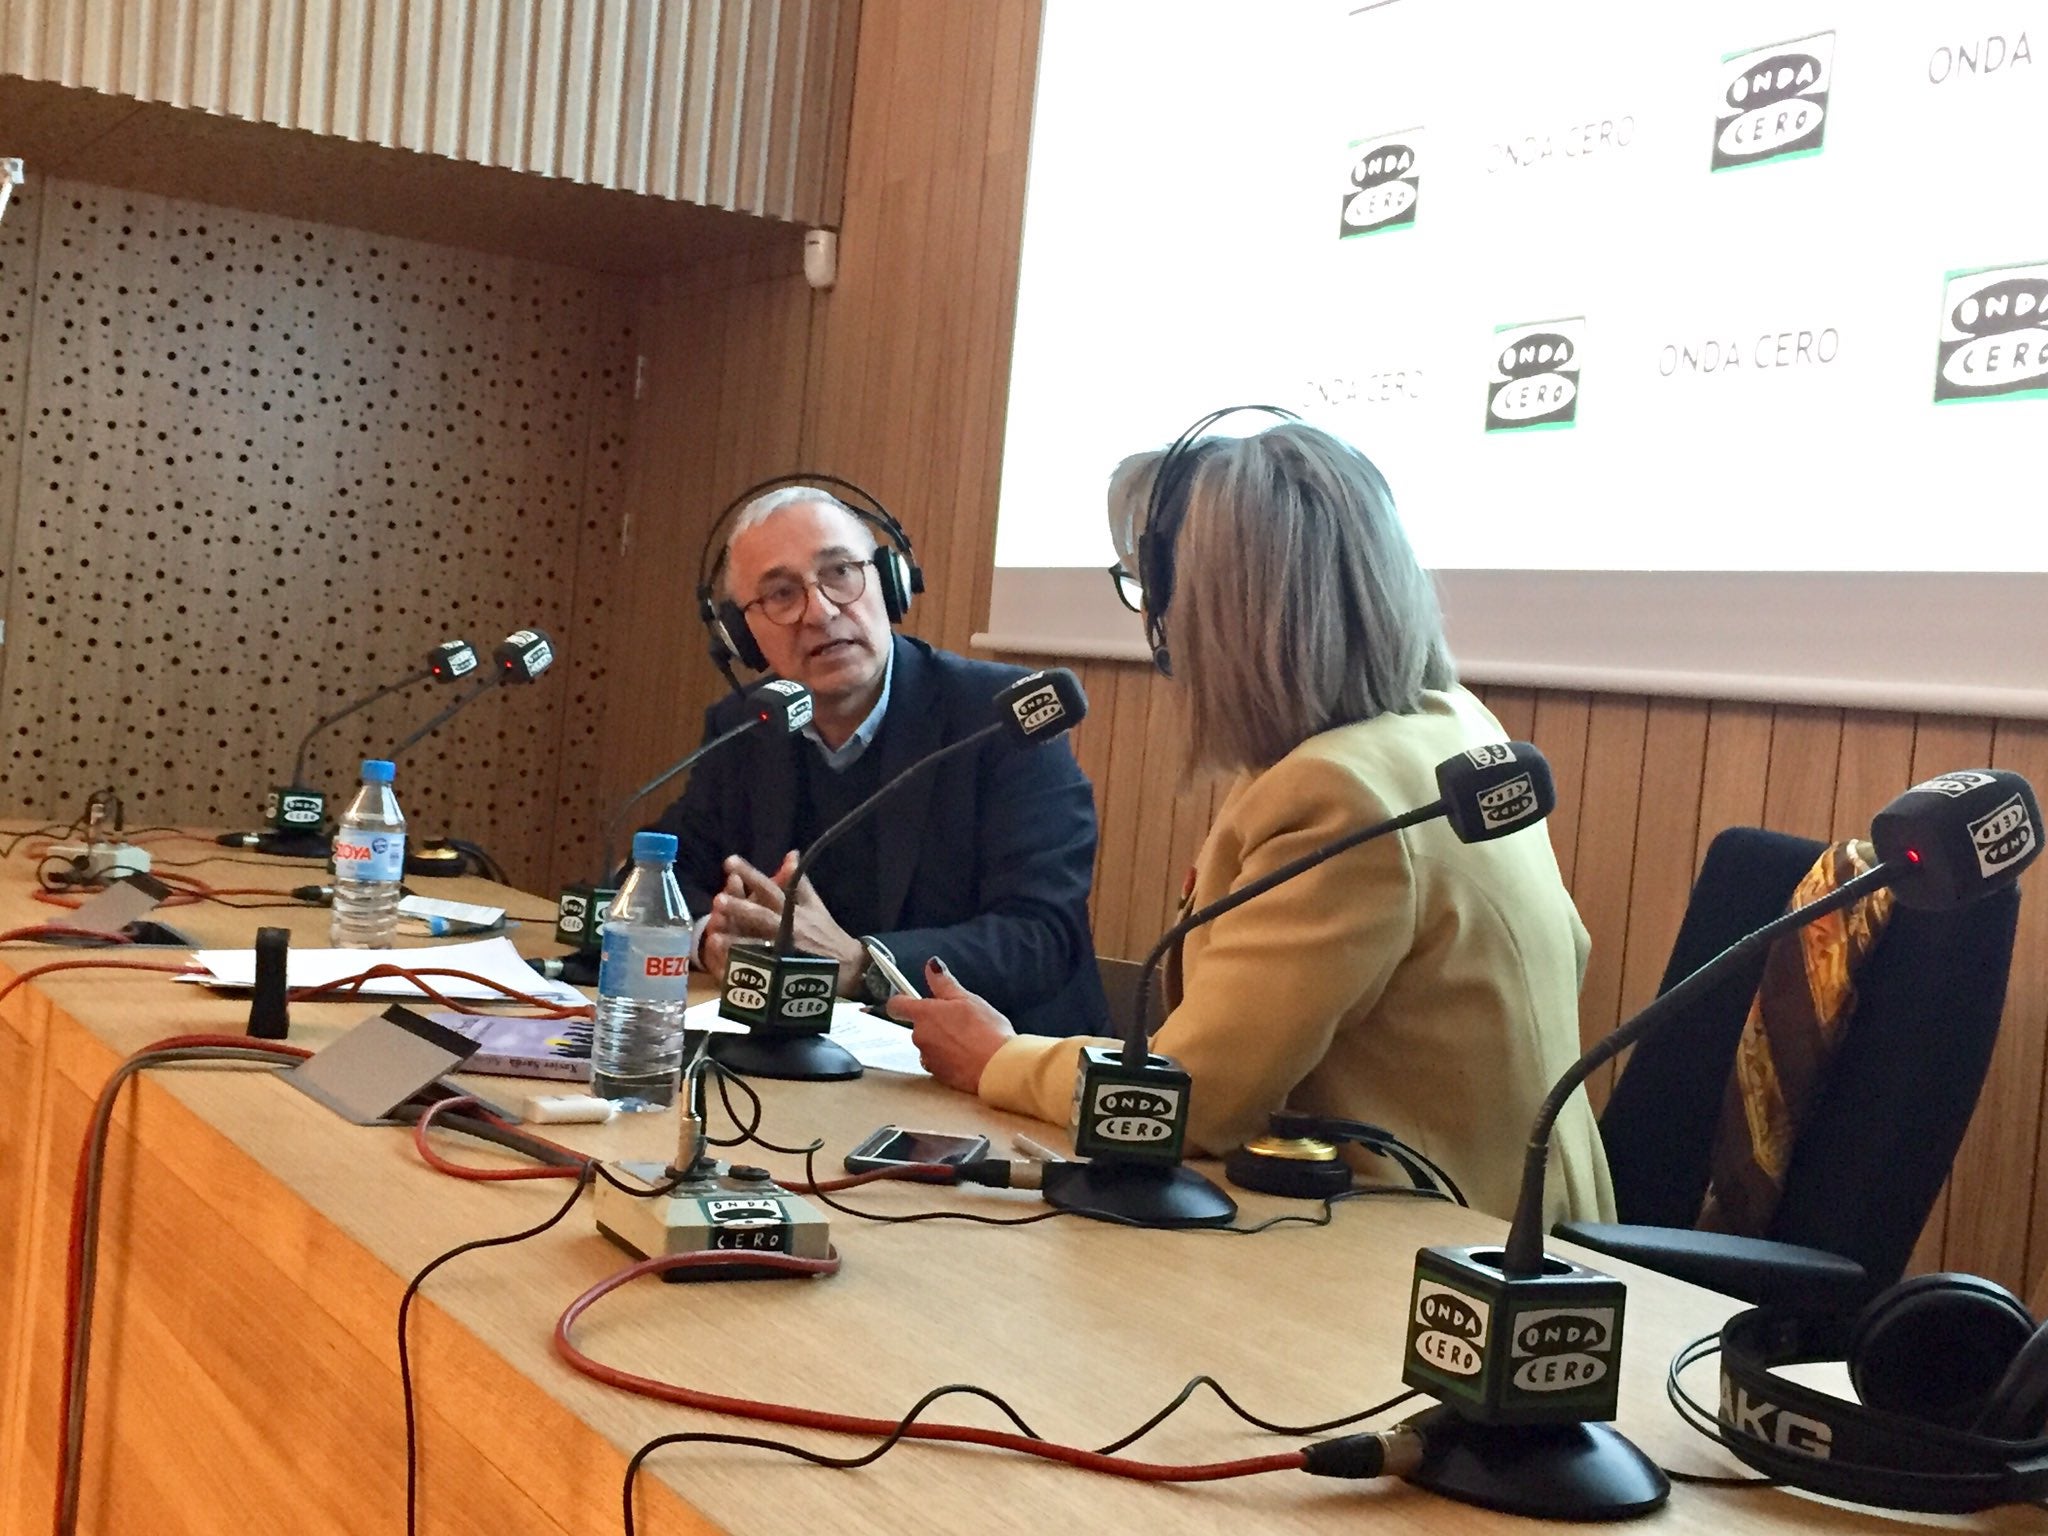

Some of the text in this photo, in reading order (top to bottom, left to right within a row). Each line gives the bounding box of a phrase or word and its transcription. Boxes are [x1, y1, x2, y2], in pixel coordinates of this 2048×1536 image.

[1929, 32, 2032, 84] ONDA
[1732, 62, 1814, 102] ONDA
[1566, 116, 1635, 158] CERO
[1734, 110, 1808, 144] CERO
[1354, 151, 1410, 182] ONDA
[1503, 342, 1568, 370] ONDA
[1659, 327, 1839, 376] ONDA CERO
[1505, 384, 1563, 408] CERO
[1020, 694, 1051, 714] ONDA
[1487, 784, 1523, 804] CERO
[1490, 799, 1530, 819] ONDA
[1982, 810, 2019, 839] CERO
[1989, 829, 2028, 860] ONDA
[645, 956, 688, 976] BEZ
[733, 971, 764, 987] ONDA
[788, 983, 826, 994] ONDA
[732, 990, 761, 1007] CERO
[788, 1001, 823, 1013] CERO
[1106, 1095, 1165, 1112] ONDA
[1106, 1121, 1162, 1137] CERO
[714, 1201, 771, 1210] ONDA
[717, 1232, 779, 1249] CERO
[1425, 1298, 1477, 1334] ONDA
[1525, 1326, 1599, 1346] ONDA
[1425, 1335, 1473, 1370] CERO
[1527, 1361, 1595, 1384] CERO
[1721, 1372, 1832, 1460] AKG
